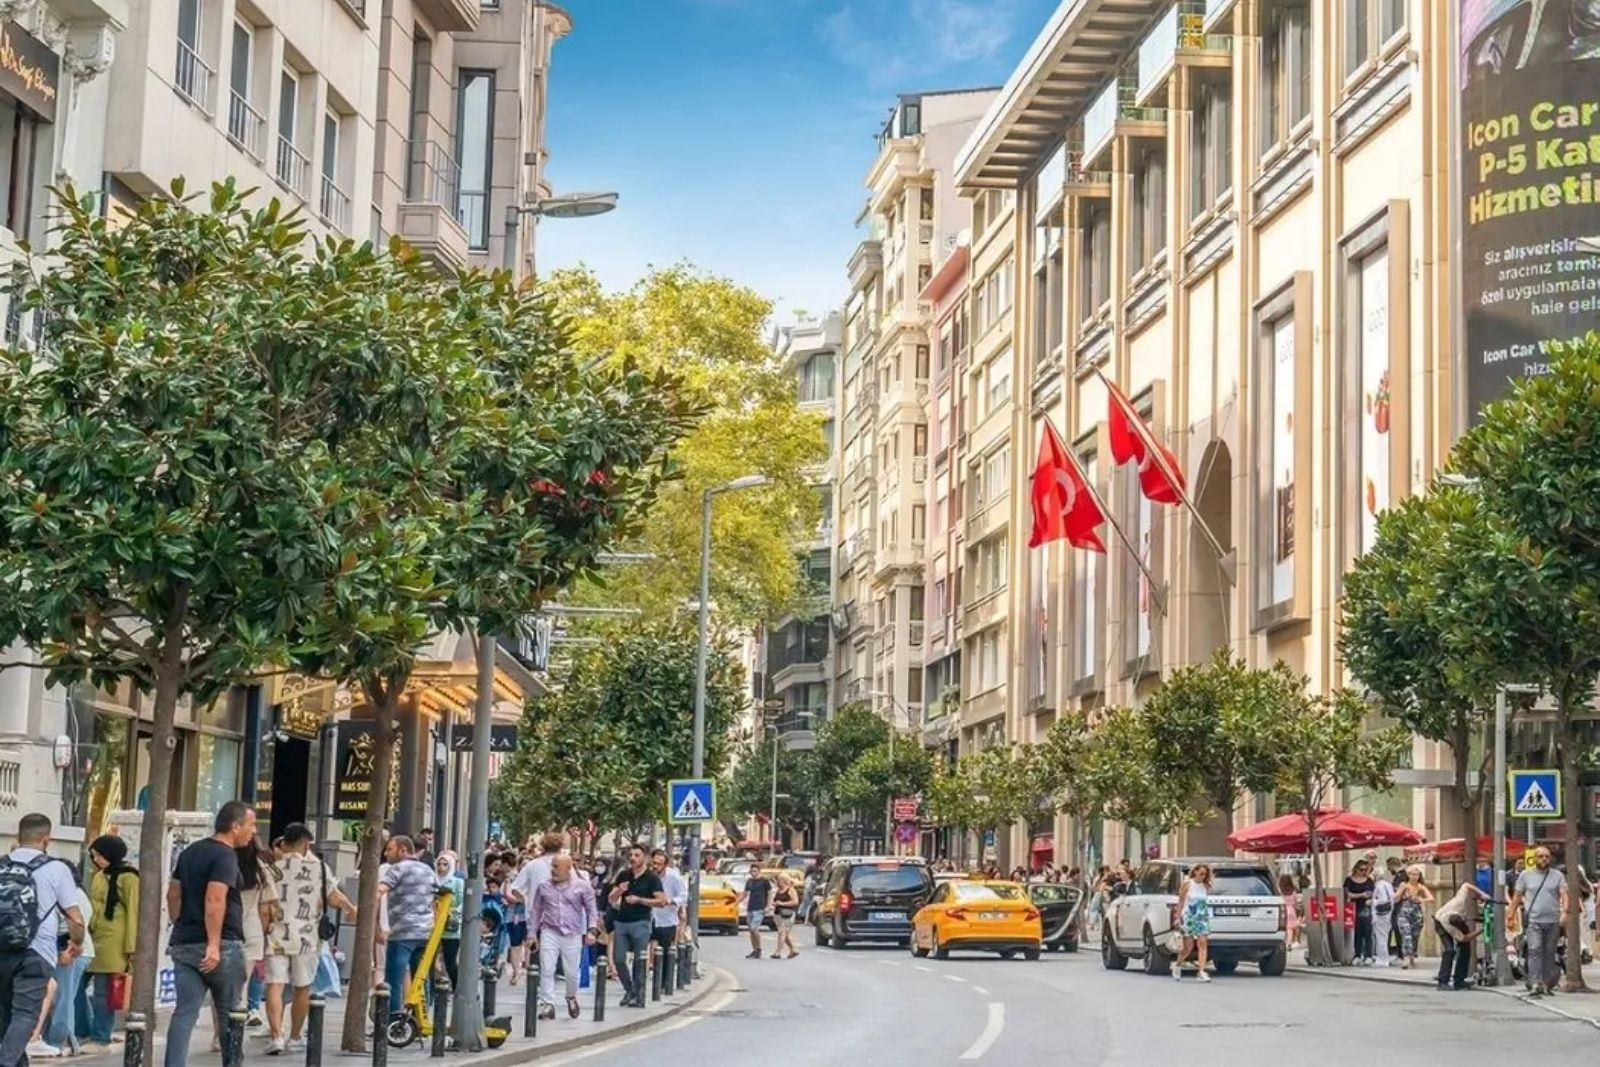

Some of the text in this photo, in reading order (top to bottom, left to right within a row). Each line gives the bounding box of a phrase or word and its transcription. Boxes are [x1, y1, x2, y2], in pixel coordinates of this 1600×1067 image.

[1468, 101, 1598, 150] Icon Car
[1480, 143, 1527, 183] P-5
[1484, 249, 1501, 266] Siz
[1531, 299, 1564, 316] hale
[1483, 348, 1508, 365] Icon
[1510, 343, 1536, 358] Car
[455, 735, 513, 747] ZRA
